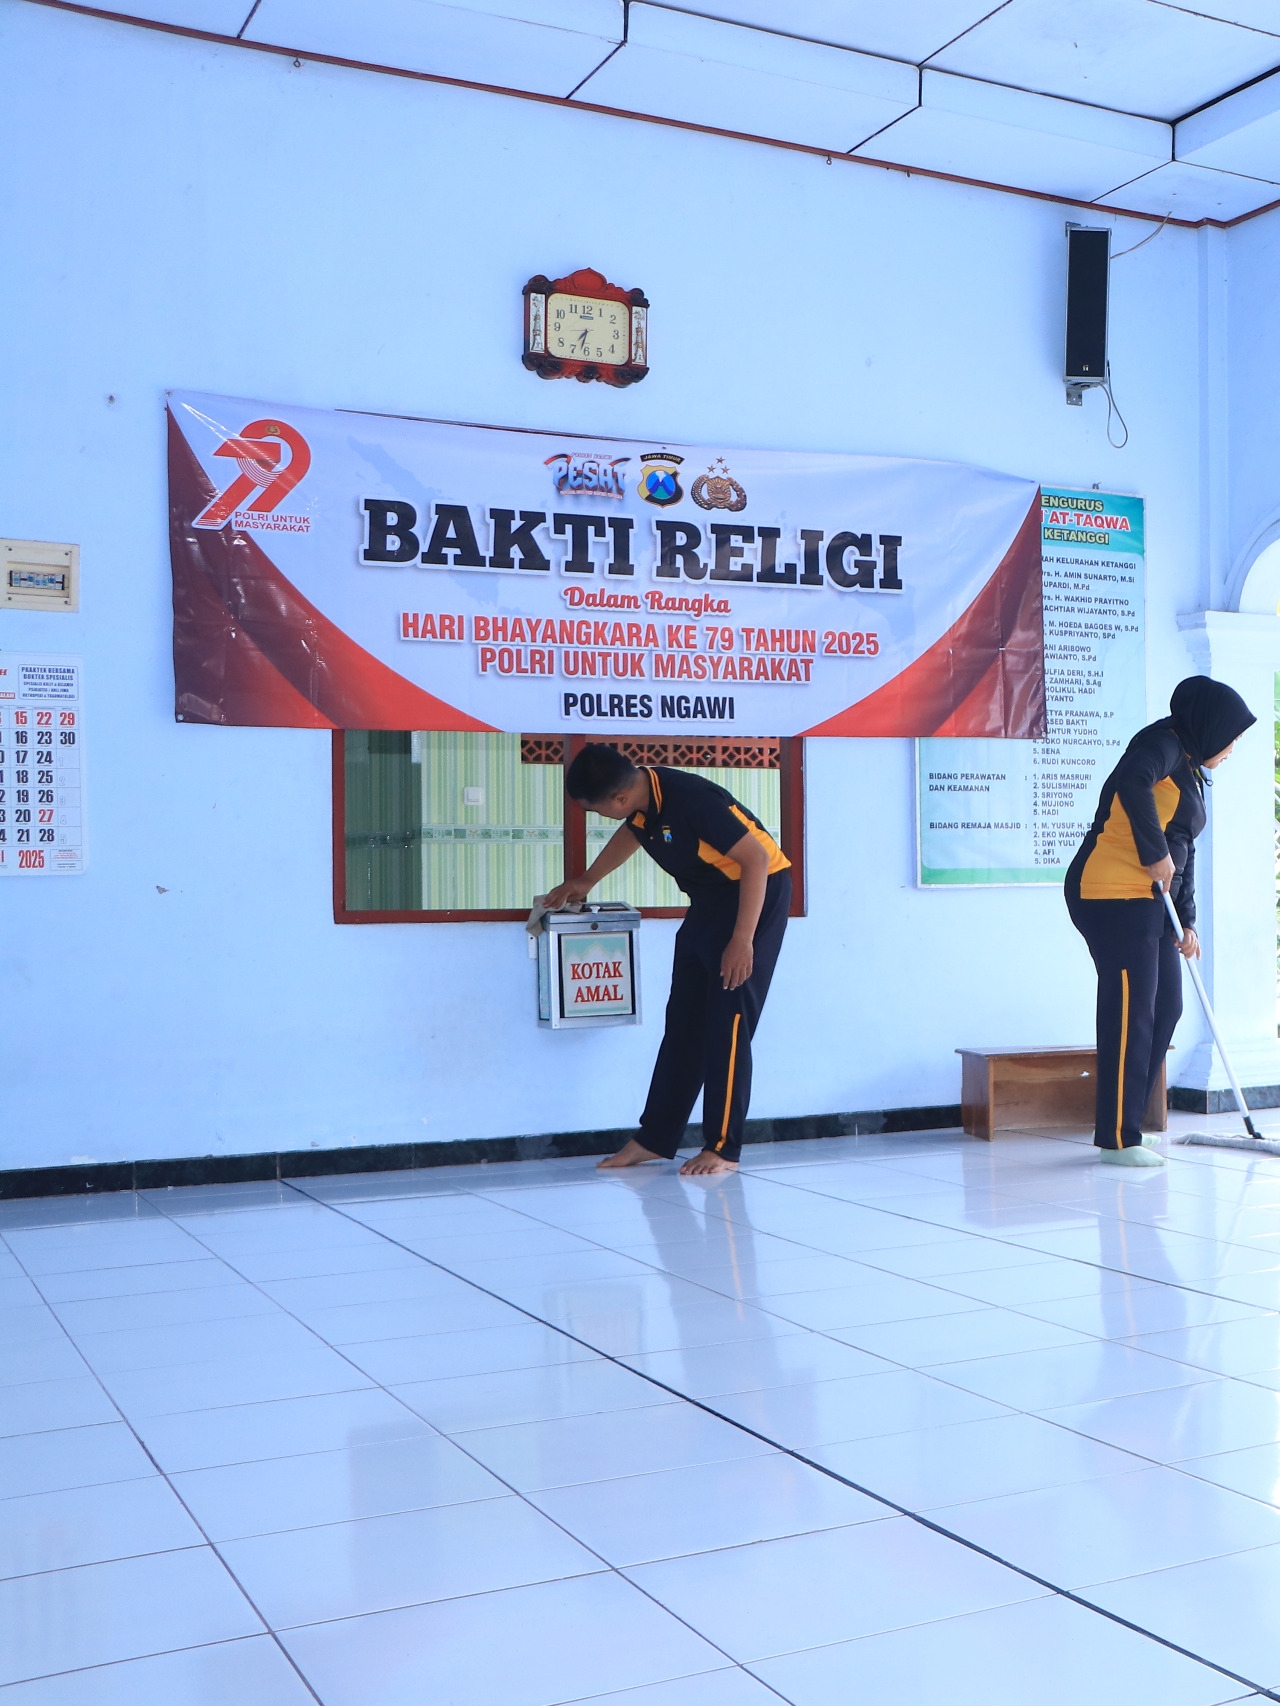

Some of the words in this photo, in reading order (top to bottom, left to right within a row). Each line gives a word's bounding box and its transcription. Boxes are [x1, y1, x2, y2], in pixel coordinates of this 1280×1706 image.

[556, 309, 566, 319] 10
[569, 304, 578, 314] 11
[582, 305, 593, 315] 12
[598, 308, 603, 317] 1
[554, 322, 561, 331] 9
[610, 315, 617, 325] 2
[613, 330, 620, 340] 3
[558, 337, 565, 347] 8
[569, 344, 577, 354] 7
[583, 347, 590, 356] 6
[596, 348, 603, 357] 5
[608, 344, 616, 354] 4
[548, 456, 629, 494] PESAT
[1041, 495, 1103, 512] ENGURUS
[234, 511, 269, 521] POLRI
[272, 514, 311, 525] UNTUK
[234, 520, 311, 533] MASYARAKAT
[1044, 528, 1109, 545] KETANGGI
[363, 498, 635, 576] BAKTI
[655, 519, 903, 590] RELIGI
[1056, 557, 1099, 566] KELURAHAN
[1101, 561, 1136, 570] KETANGGI
[1064, 571, 1082, 579] AMIN
[1084, 573, 1119, 583] SUNARTO,
[1043, 581, 1072, 590] UPARDI,
[1073, 583, 1090, 591] M.Pd
[563, 586, 641, 609] Dalam
[645, 589, 731, 617] Rangka
[1064, 595, 1093, 604] WAKHID
[1094, 597, 1129, 606] PRAYITNO
[1043, 605, 1076, 613] ACHTIAR
[1077, 607, 1119, 617] WIJAYANTO,
[1048, 620, 1057, 628] M.
[1058, 621, 1082, 629] HOEDA
[1084, 622, 1113, 631] BAGOES
[1114, 624, 1123, 632] W,
[1124, 625, 1139, 633] S.Pd
[402, 612, 464, 640] HARI
[474, 616, 659, 648] BHAYANGKARA
[667, 624, 697, 649] KE
[705, 626, 733, 651] 79
[742, 627, 816, 654] TAHUN
[824, 631, 879, 656] 2025
[1049, 629, 1101, 640] KUSPRIYANTO,
[1058, 645, 1092, 653] ARIBOWO
[1044, 653, 1080, 662] AWIANTO,
[1081, 654, 1097, 662] S.Pd
[480, 647, 554, 675] POLRI
[564, 650, 645, 677] UNTUK
[654, 652, 813, 682] MASYARAKAT
[1044, 668, 1065, 676] ULFIA
[1067, 669, 1086, 678] DERI,
[1087, 670, 1104, 678] S.H.I
[1049, 677, 1084, 686] ZAMHARI,
[1085, 679, 1102, 687] S.Ag
[1045, 686, 1077, 694] HOLIKUL
[1078, 687, 1095, 695] HADI
[563, 692, 652, 718] POLRES
[661, 695, 735, 720] NGAWI
[14, 711, 28, 725] 15
[36, 711, 52, 725] 22
[59, 712, 75, 726] 29
[1046, 709, 1063, 717] ETYA
[1065, 709, 1102, 719] PRANAWA,
[15, 730, 28, 744] 16
[37, 731, 53, 745] 23
[60, 731, 76, 745] 30
[1073, 728, 1098, 736] YUDHO
[1062, 738, 1104, 747] NURCAHYO,
[15, 750, 29, 764] 17
[36, 750, 54, 764] 24
[1061, 758, 1096, 766] KUNCORO
[15, 770, 29, 784] 18
[38, 770, 53, 784] 25
[929, 772, 958, 780] BIDANG
[960, 773, 1006, 781] PERAWATAN
[929, 784, 945, 792] DAN
[947, 784, 990, 792] KEAMANAN
[1041, 782, 1087, 790] SULISMIHADI
[16, 789, 29, 803] 19
[38, 789, 54, 803] 26
[15, 809, 31, 823] 20
[38, 809, 54, 823] 27
[17, 829, 30, 842] 21
[39, 829, 55, 842] 28
[18, 850, 45, 869] 2025
[570, 961, 623, 980] KOTAK
[574, 984, 624, 1004] AMAL
